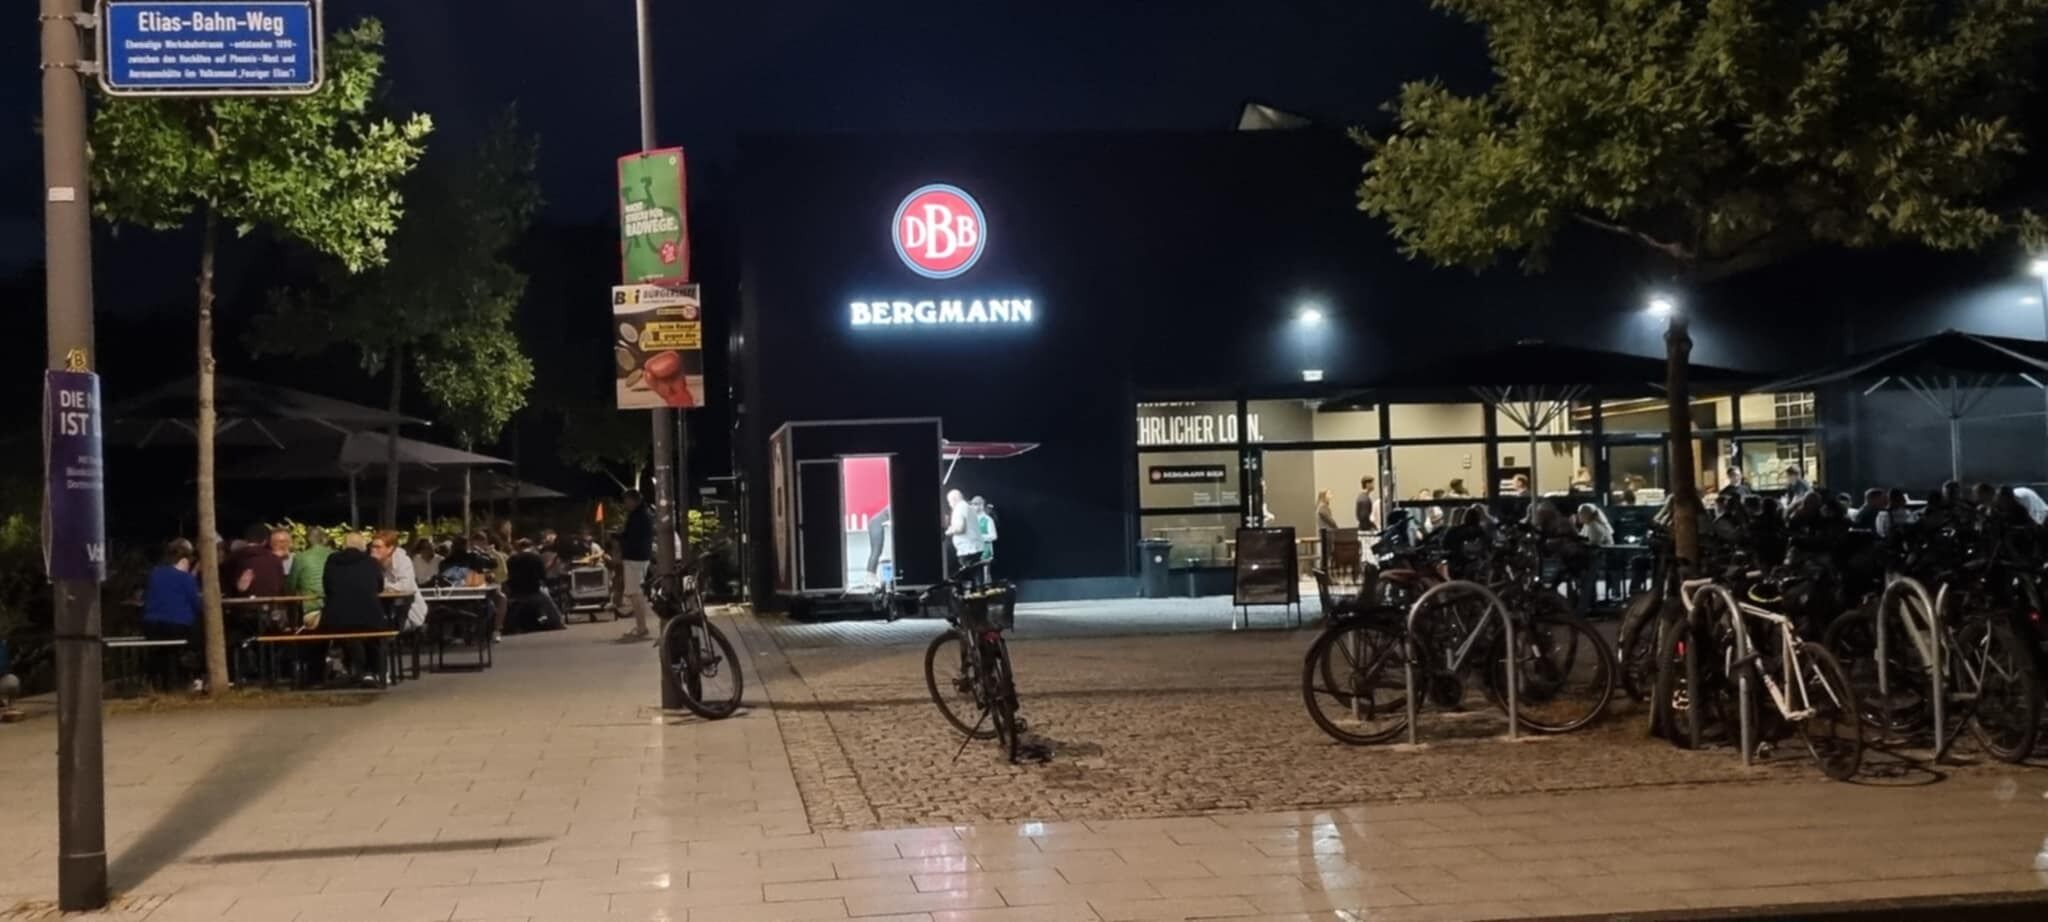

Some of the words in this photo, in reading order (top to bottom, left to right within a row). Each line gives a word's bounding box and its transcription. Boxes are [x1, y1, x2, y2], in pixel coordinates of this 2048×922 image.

[138, 11, 284, 37] Elias-Bahn-Weg
[905, 203, 977, 258] DBB
[850, 299, 1033, 325] BERGMANN
[60, 389, 85, 408] DIE
[61, 411, 89, 436] IST
[1218, 413, 1264, 444] LON.
